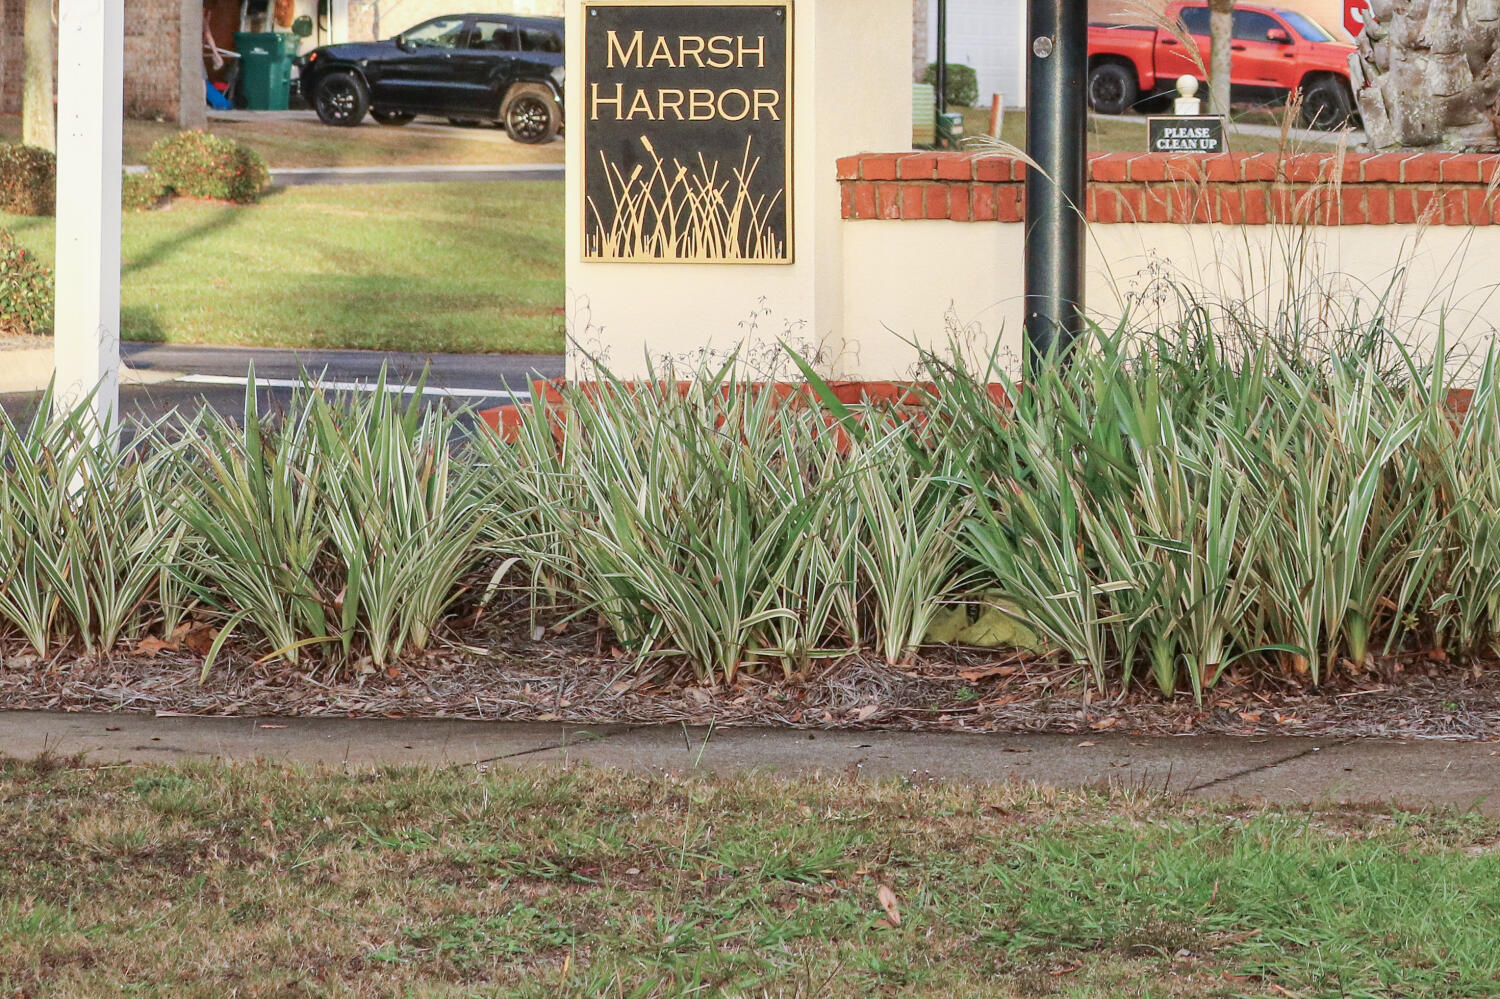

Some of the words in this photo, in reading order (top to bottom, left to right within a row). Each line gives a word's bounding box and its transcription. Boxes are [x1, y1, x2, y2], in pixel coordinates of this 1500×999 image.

[606, 30, 765, 68] MARSH
[590, 82, 781, 121] HARBOR
[1156, 138, 1198, 149] CLEAN
[1199, 138, 1218, 149] UP
[1164, 127, 1210, 138] PLEASE
